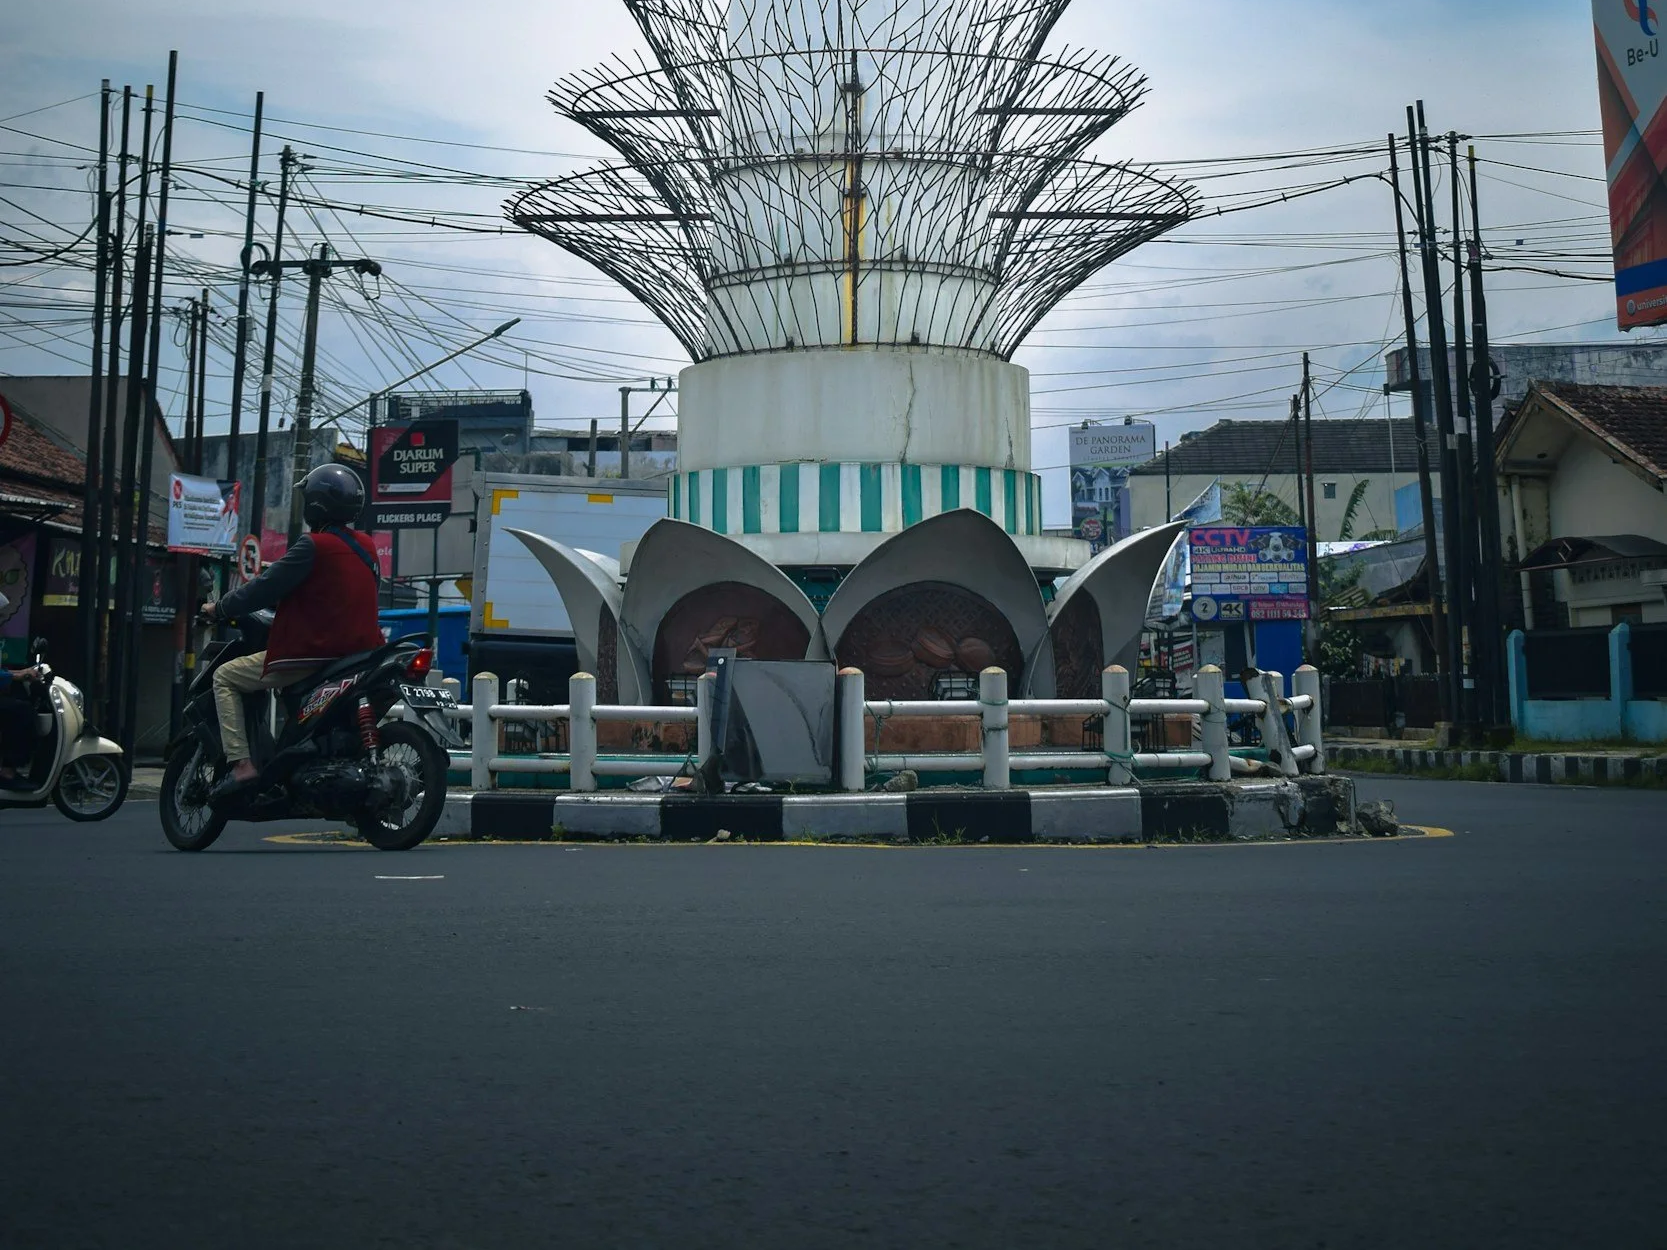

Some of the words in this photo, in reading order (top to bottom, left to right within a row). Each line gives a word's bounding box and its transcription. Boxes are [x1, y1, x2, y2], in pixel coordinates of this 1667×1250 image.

[1627, 38, 1659, 66] Be-U
[1637, 295, 1667, 310] universi
[1076, 437, 1088, 445] DE
[1091, 435, 1146, 445] PANORAMA
[393, 448, 444, 462] DJARUM
[1090, 445, 1131, 455] GARDEN
[400, 462, 436, 474] SUPER
[377, 513, 415, 523] FLICKERS
[416, 513, 442, 522] PLACE
[1190, 529, 1250, 546] CCTV
[1222, 603, 1242, 614] 4K
